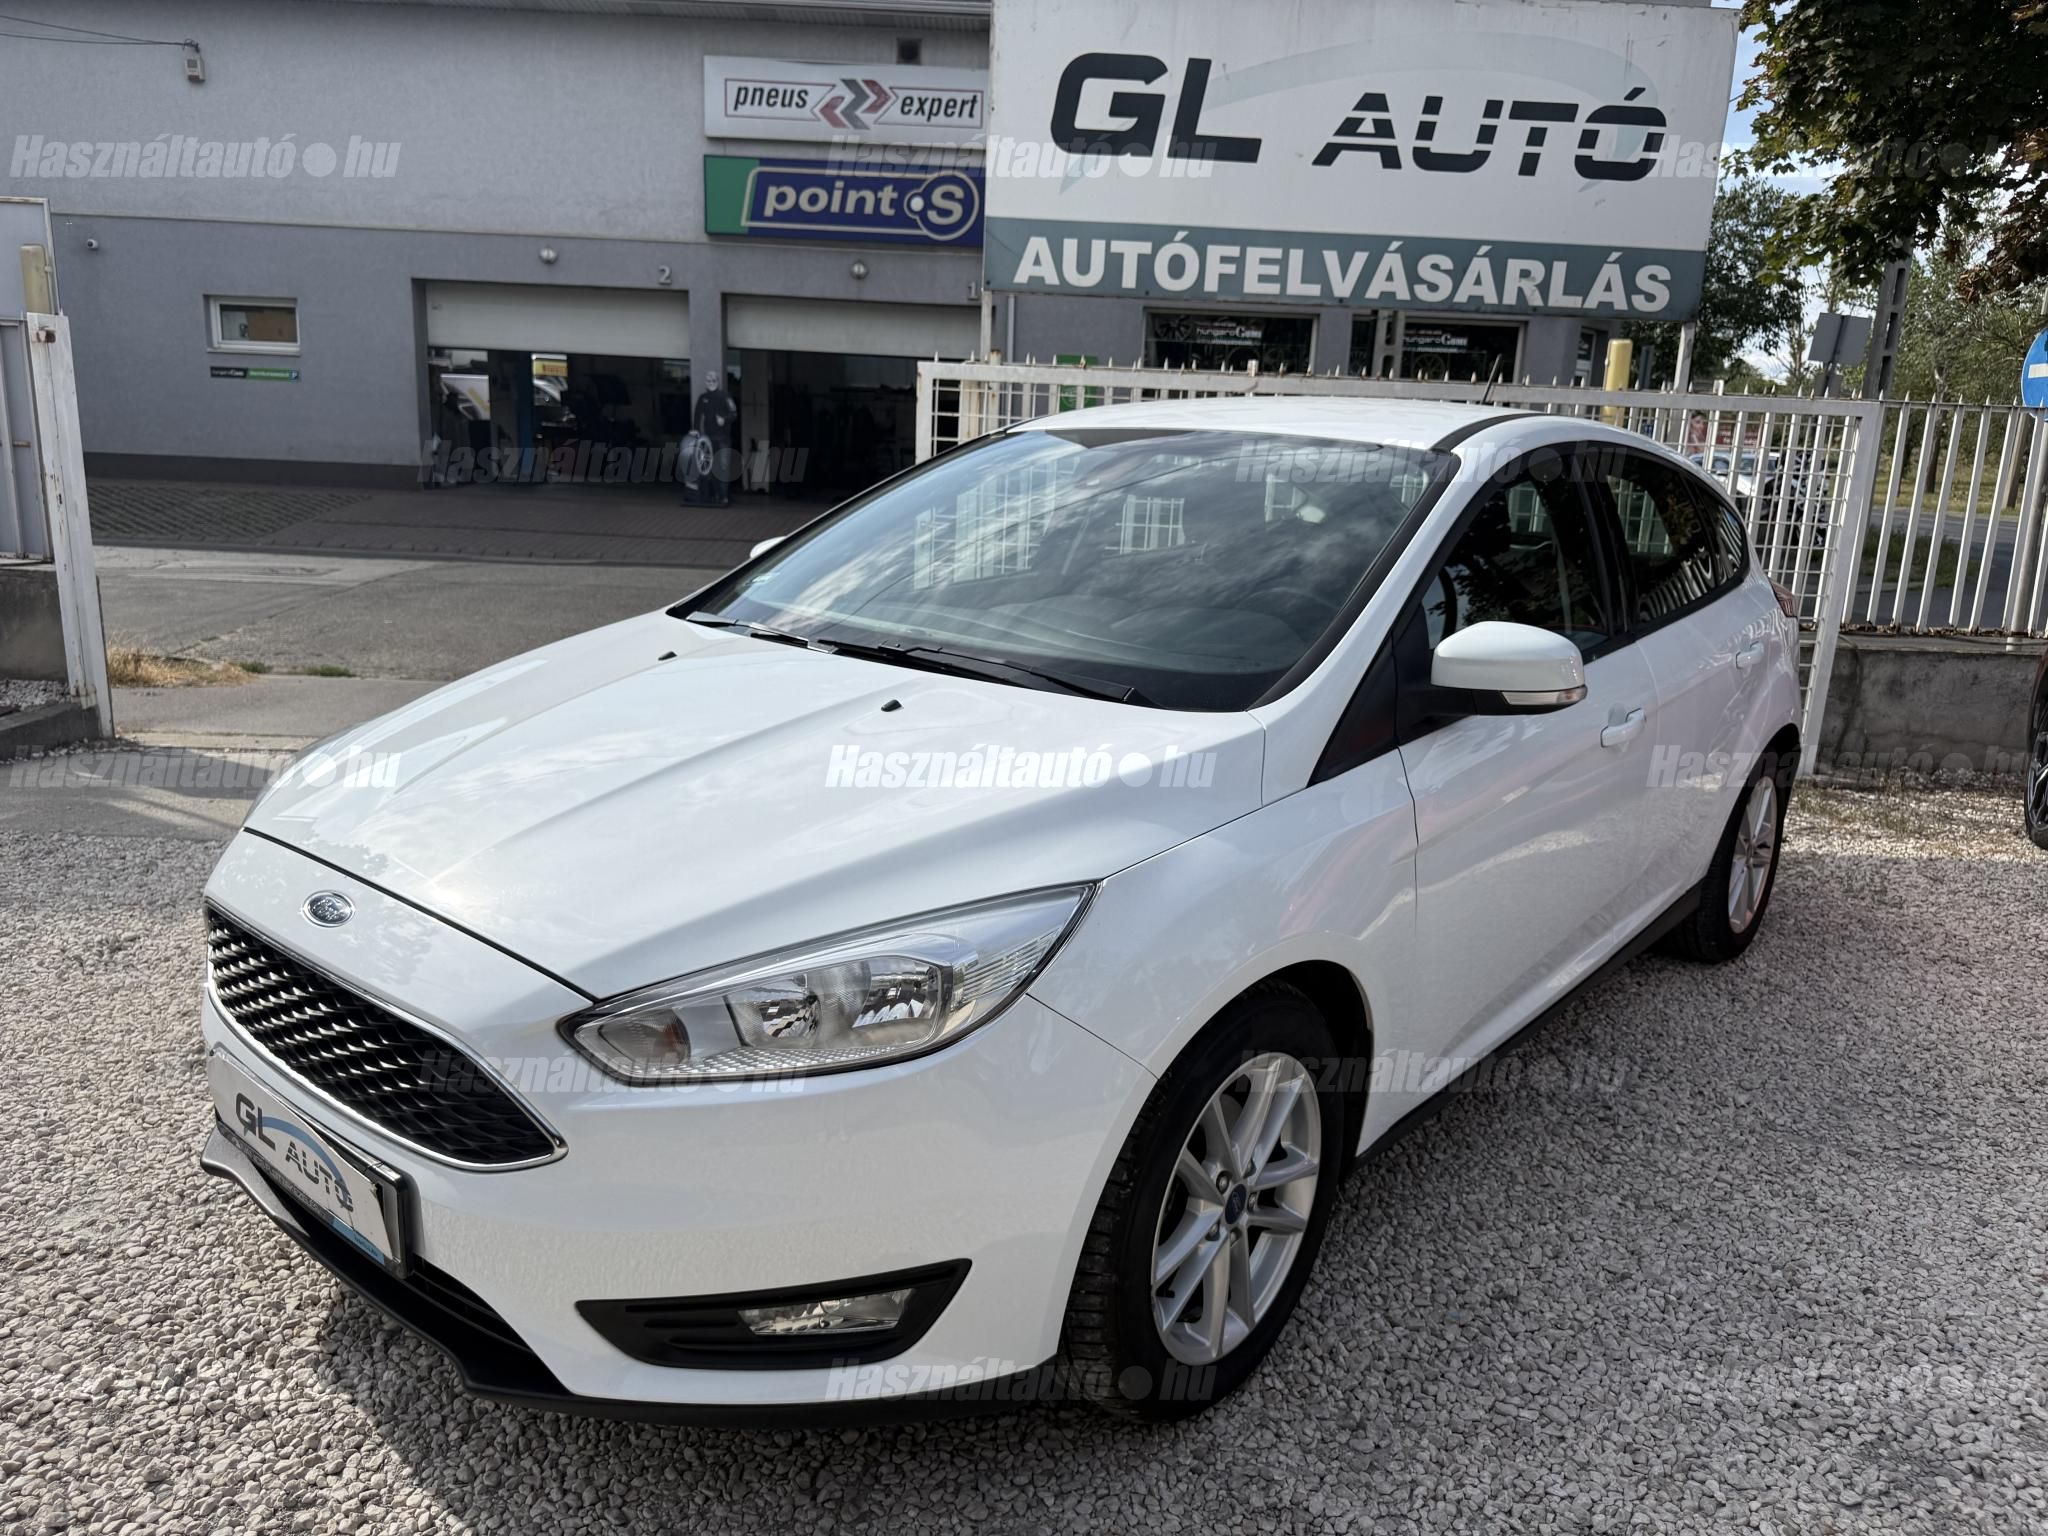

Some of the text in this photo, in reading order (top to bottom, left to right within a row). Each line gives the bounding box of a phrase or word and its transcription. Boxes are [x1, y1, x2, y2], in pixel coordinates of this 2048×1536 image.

[733, 81, 981, 122] pneus expert
[1051, 52, 1668, 182] GL AUTÓ
[763, 180, 966, 226] point S
[658, 265, 672, 286] 2
[1013, 229, 1673, 313] AUTÓFELVÁSÁRLÁS
[236, 1092, 276, 1152] GL
